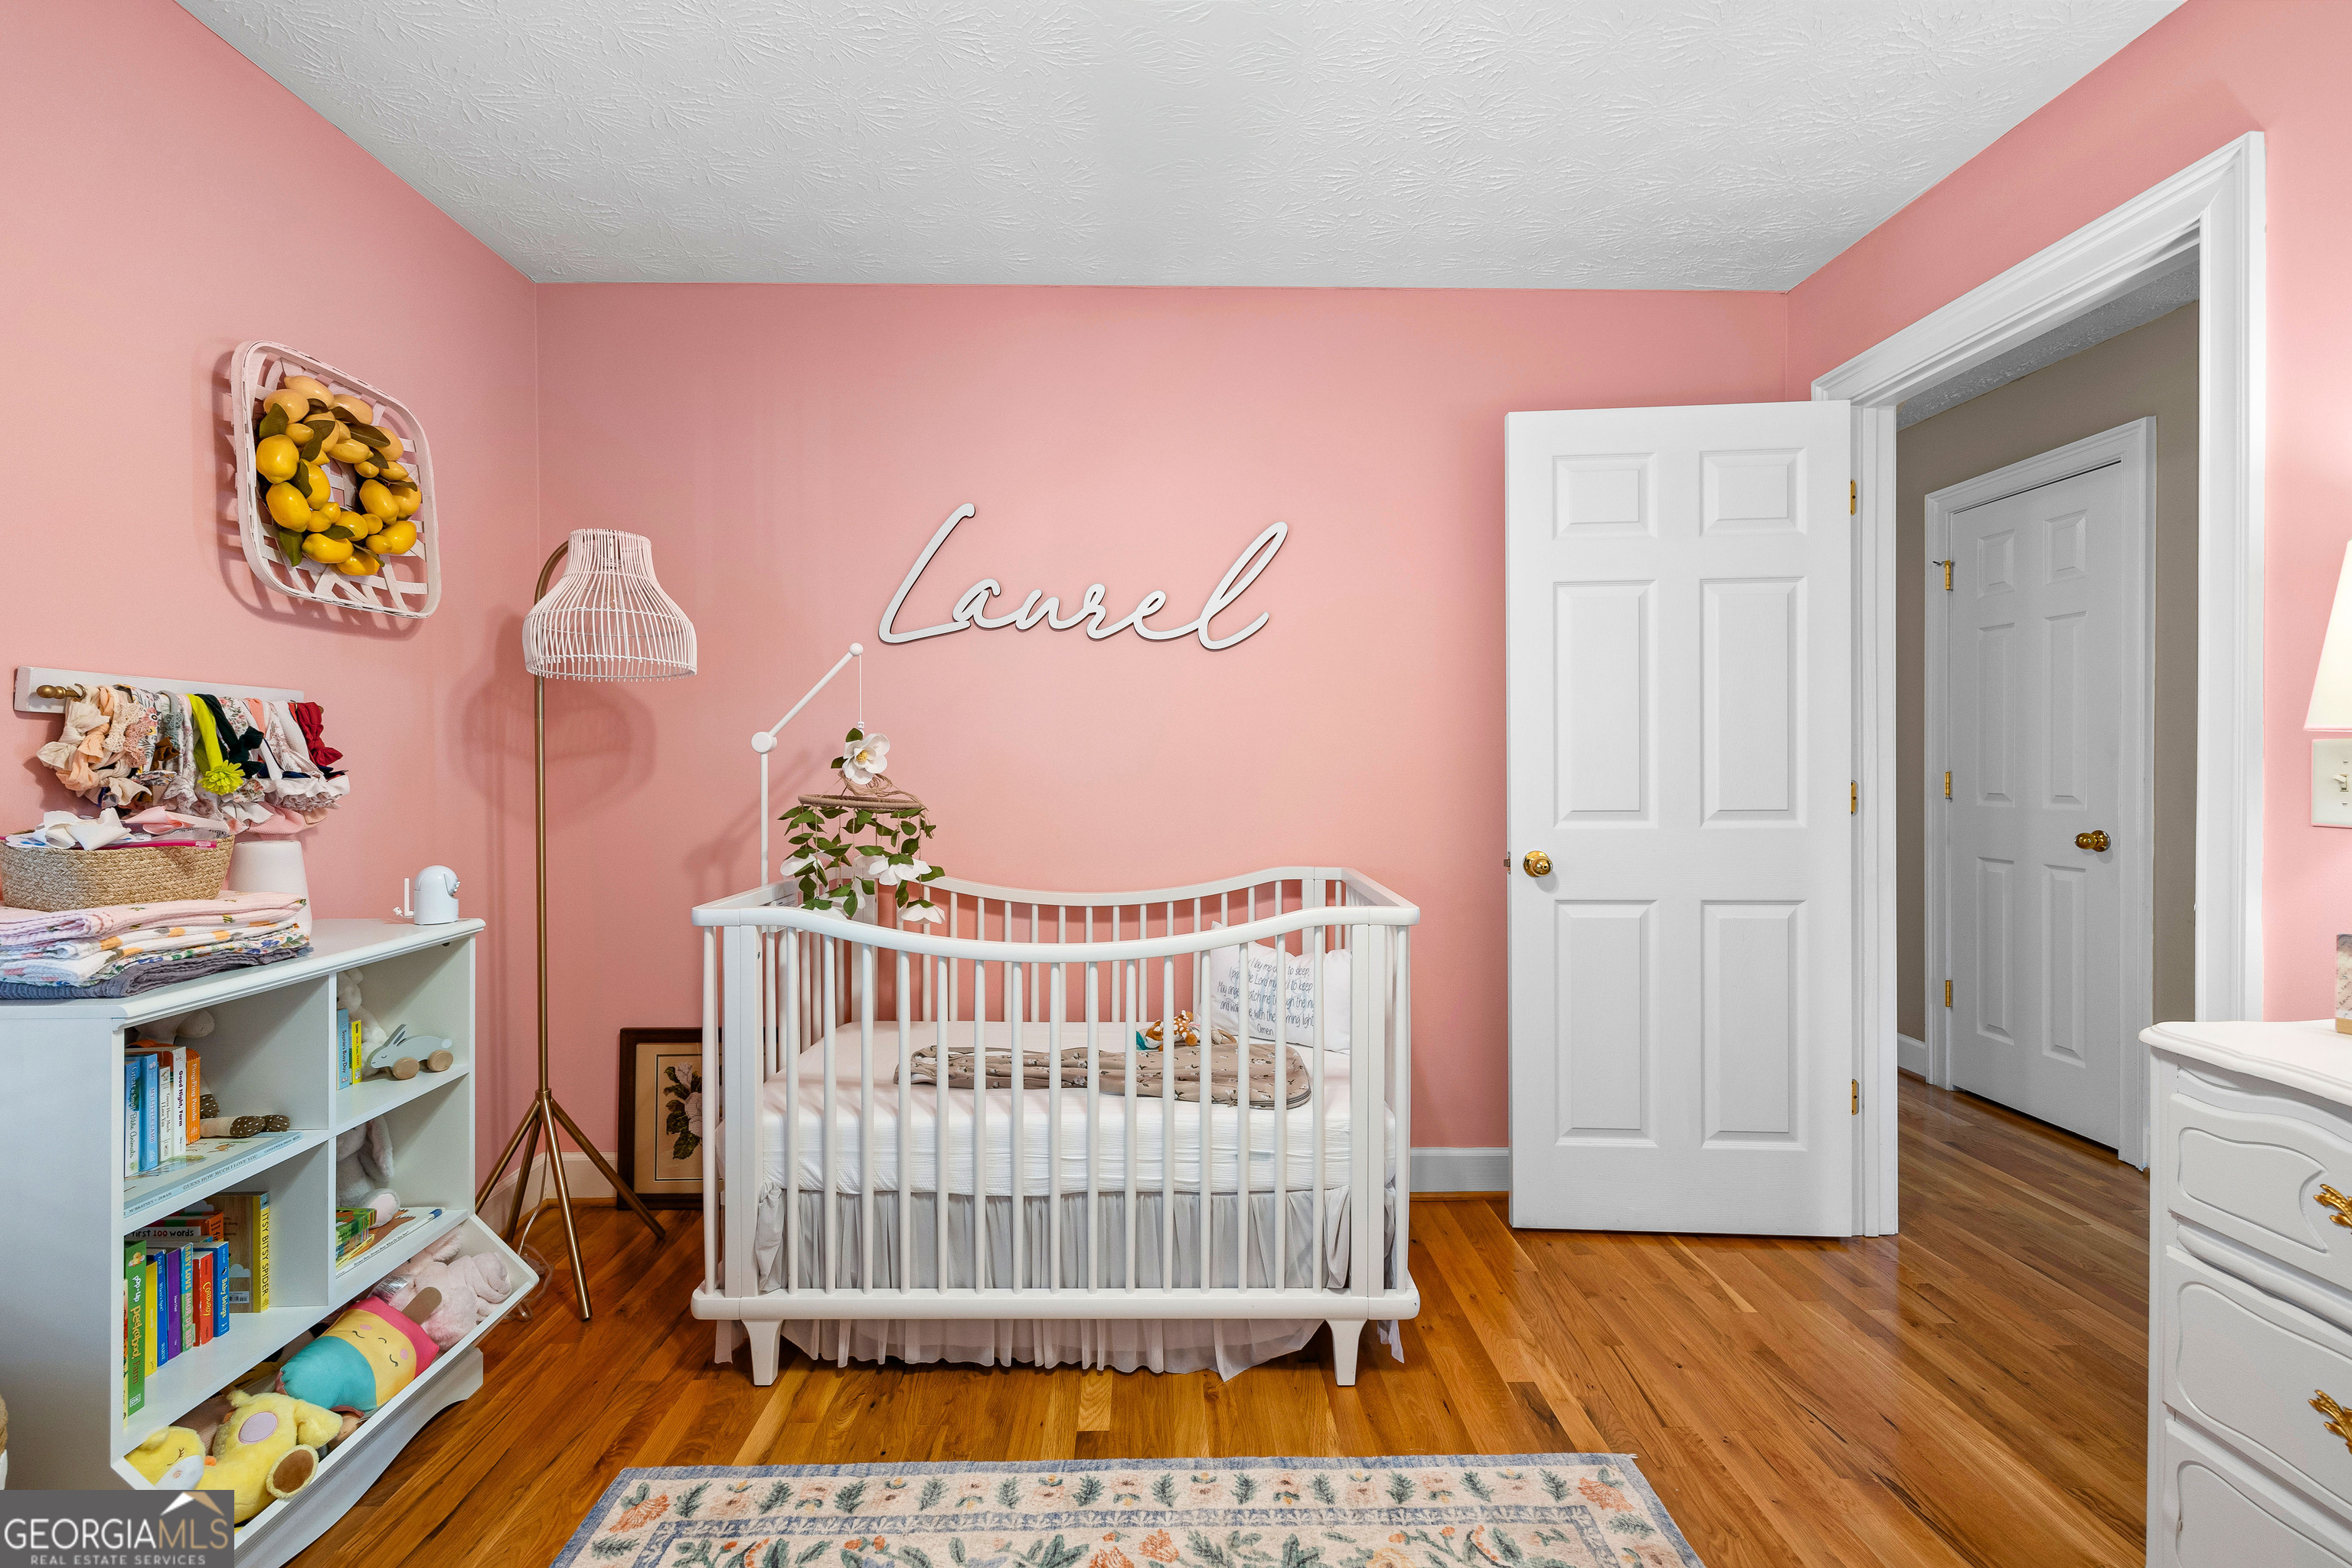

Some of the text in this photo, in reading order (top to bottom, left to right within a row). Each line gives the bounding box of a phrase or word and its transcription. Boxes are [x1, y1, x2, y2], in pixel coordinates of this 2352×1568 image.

[877, 502, 1289, 652] Laurel
[1288, 965, 1295, 975] to
[1217, 982, 1227, 997] May
[1248, 988, 1261, 1002] atch
[1262, 995, 1271, 1004] me
[1296, 995, 1305, 1008] the
[1255, 973, 1269, 987] Lord
[1269, 978, 1277, 991] my
[1291, 980, 1298, 991] to
[1298, 980, 1314, 994] keep
[1266, 1010, 1276, 1022] the
[150, 1087, 155, 1098] MY
[129, 1112, 137, 1131] Bible
[129, 1131, 137, 1159] Animals
[183, 1178, 201, 1190] GUESS
[201, 1173, 214, 1183] HOW
[214, 1166, 230, 1177] MUCH
[233, 1158, 247, 1168] LOVE
[247, 1153, 259, 1162] YOU
[131, 1228, 194, 1238] first 100 words
[132, 1275, 142, 1302] pop-up
[202, 1281, 211, 1317] CORDUROY
[130, 1305, 142, 1360] peekaboo!
[185, 1317, 192, 1327] DE
